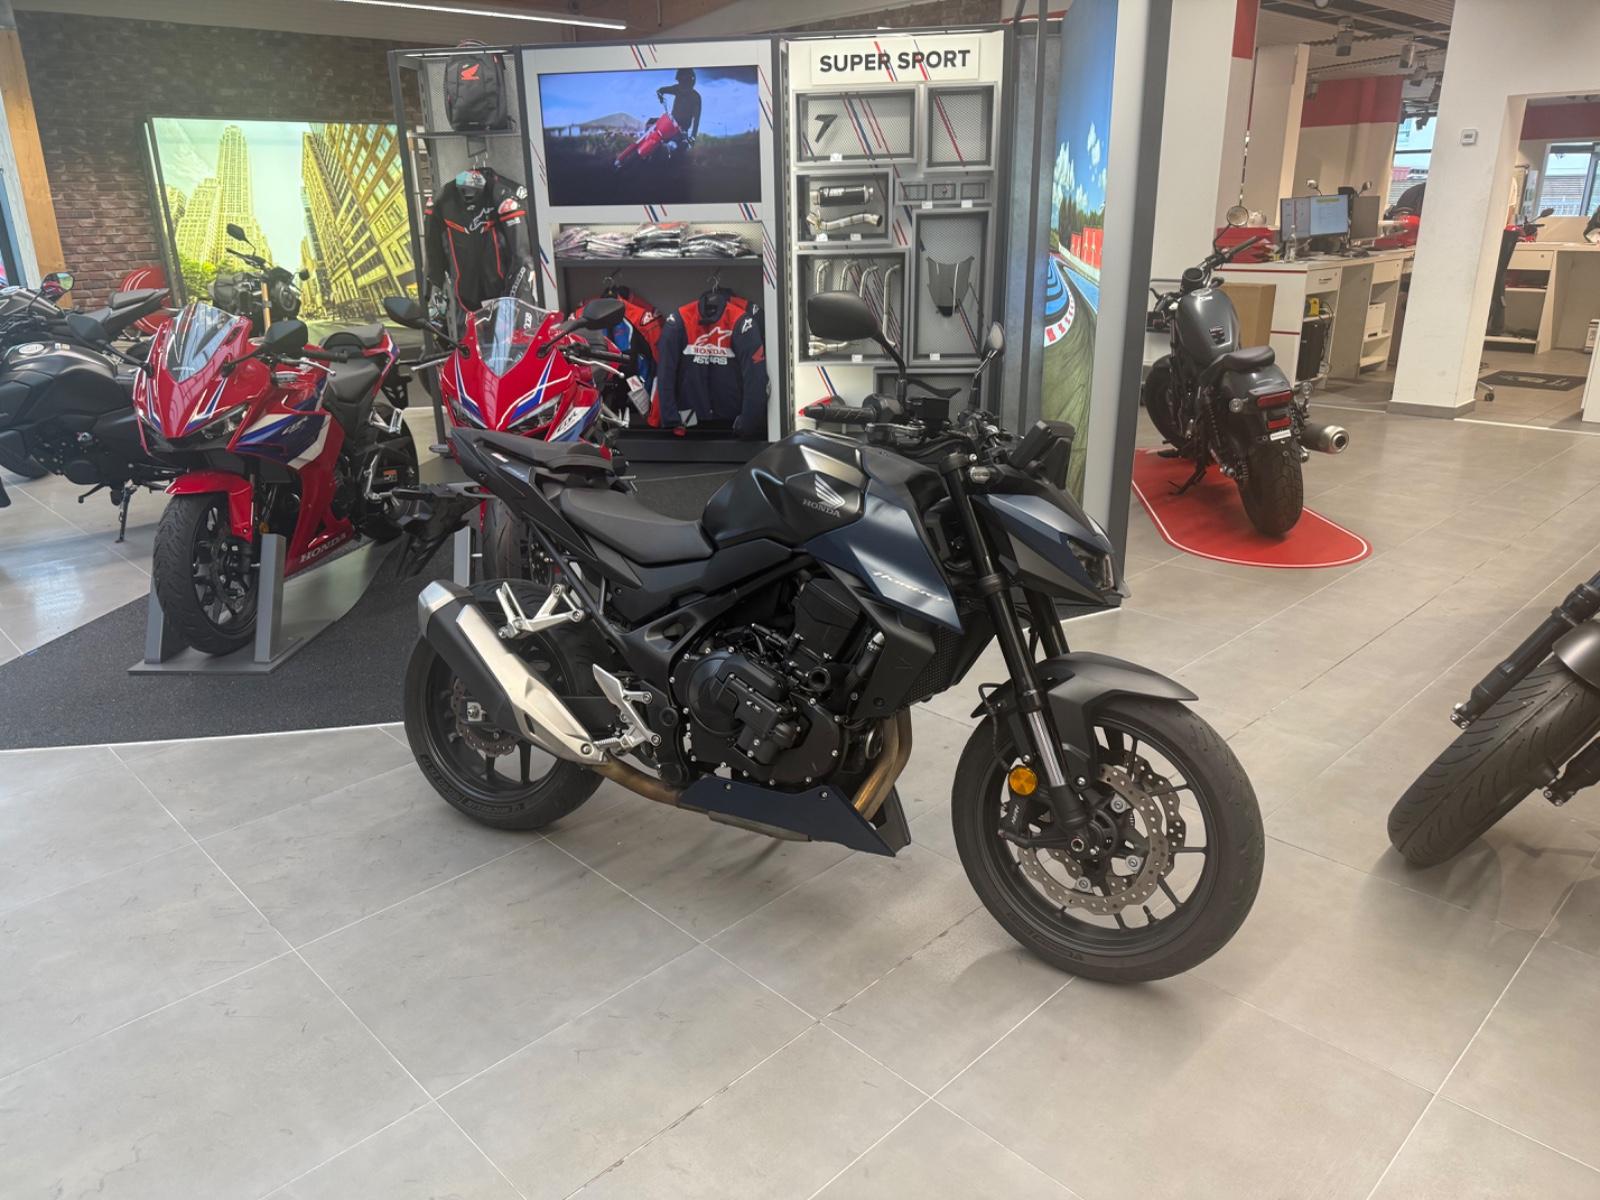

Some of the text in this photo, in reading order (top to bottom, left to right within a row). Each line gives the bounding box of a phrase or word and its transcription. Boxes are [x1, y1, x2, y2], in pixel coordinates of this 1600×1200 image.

[819, 50, 971, 73] SUPER SPORT
[802, 499, 841, 518] HONDA
[299, 532, 347, 563] HONDA
